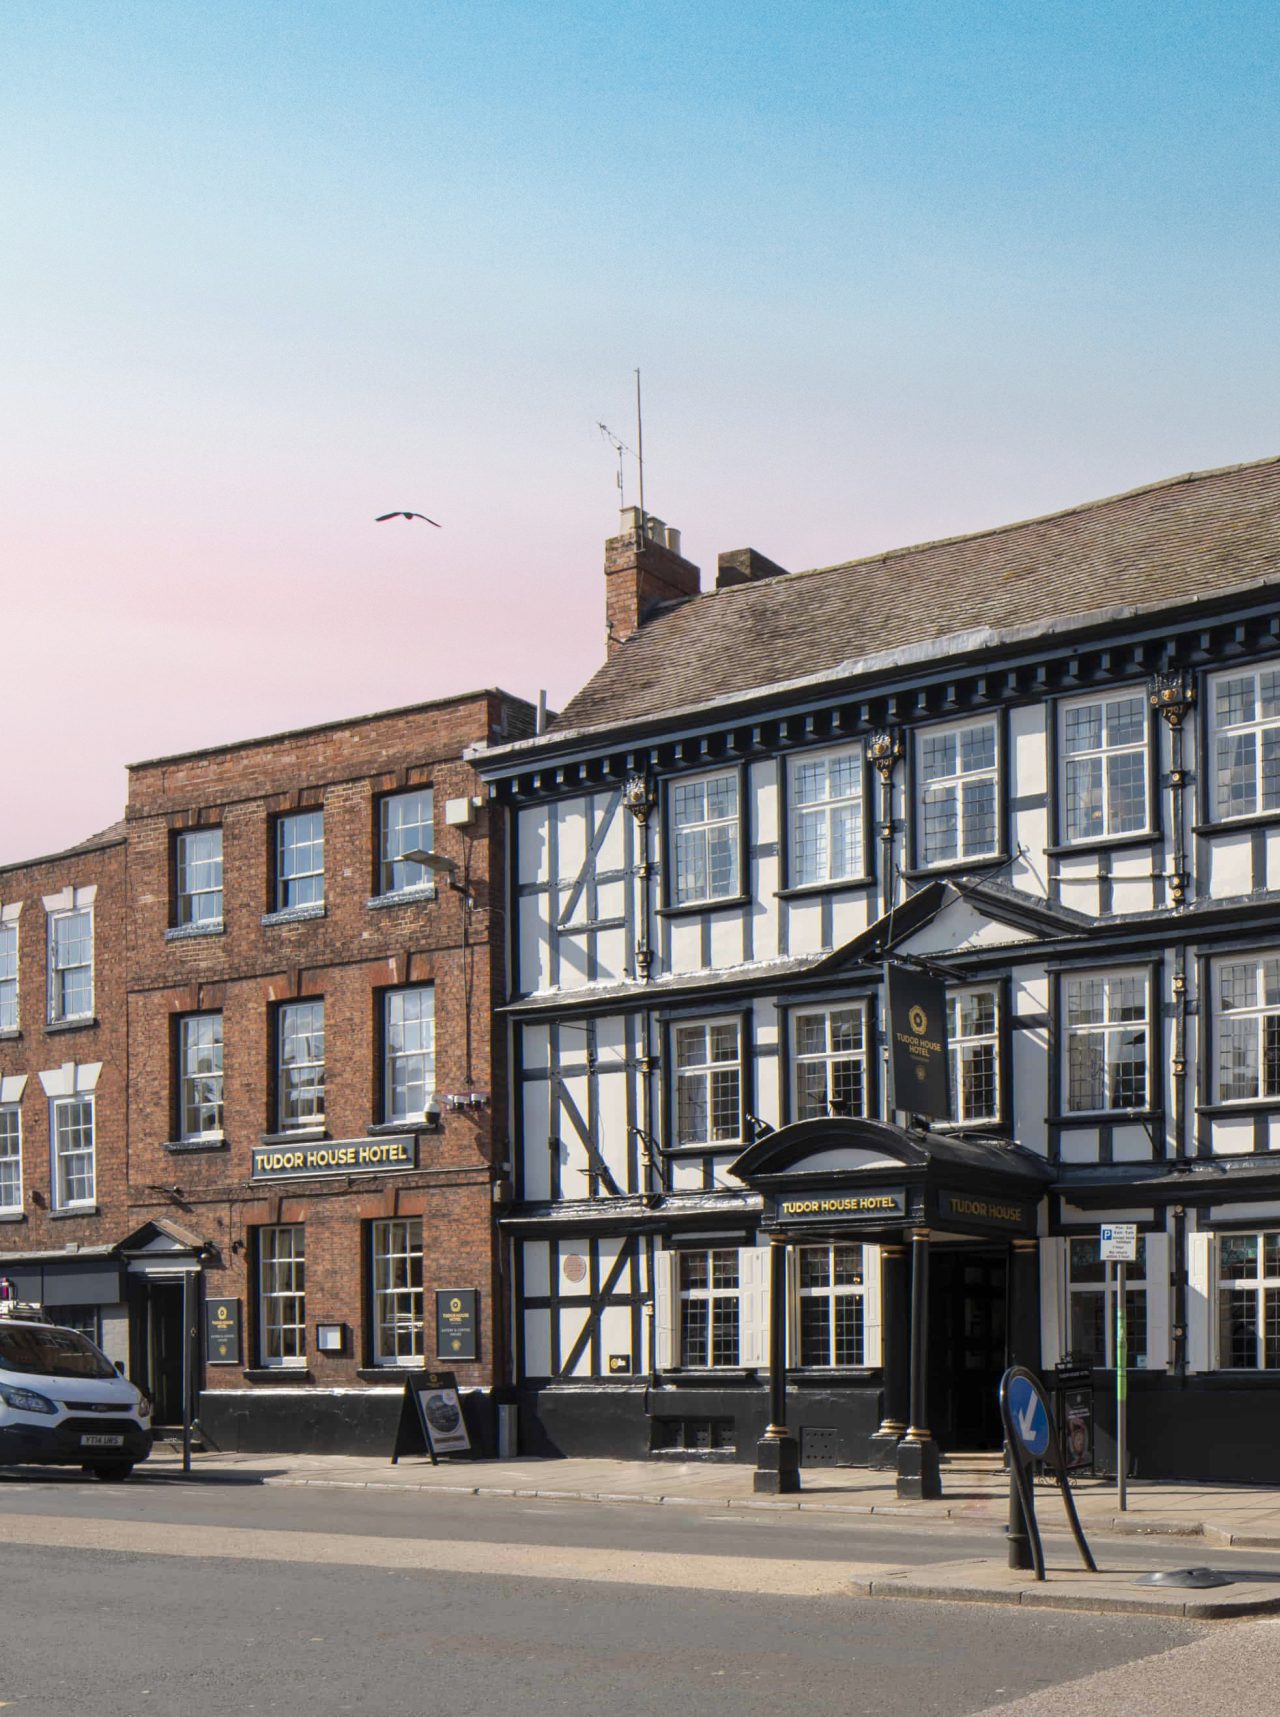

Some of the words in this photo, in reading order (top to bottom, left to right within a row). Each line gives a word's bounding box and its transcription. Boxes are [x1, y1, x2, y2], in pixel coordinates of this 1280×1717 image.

[896, 1032, 919, 1047] TUDOR
[920, 1038, 942, 1052] HOUSE
[909, 1045, 930, 1057] HOTEL
[255, 1152, 304, 1170] TUDOR
[307, 1148, 356, 1166] HOUSE
[359, 1144, 407, 1162] HOTEL
[782, 1201, 819, 1213] TUDOR
[821, 1199, 858, 1211] HOUSE
[860, 1196, 896, 1208] HOTEL
[951, 1198, 987, 1216] TUDOR
[988, 1203, 1022, 1221] HOUSE
